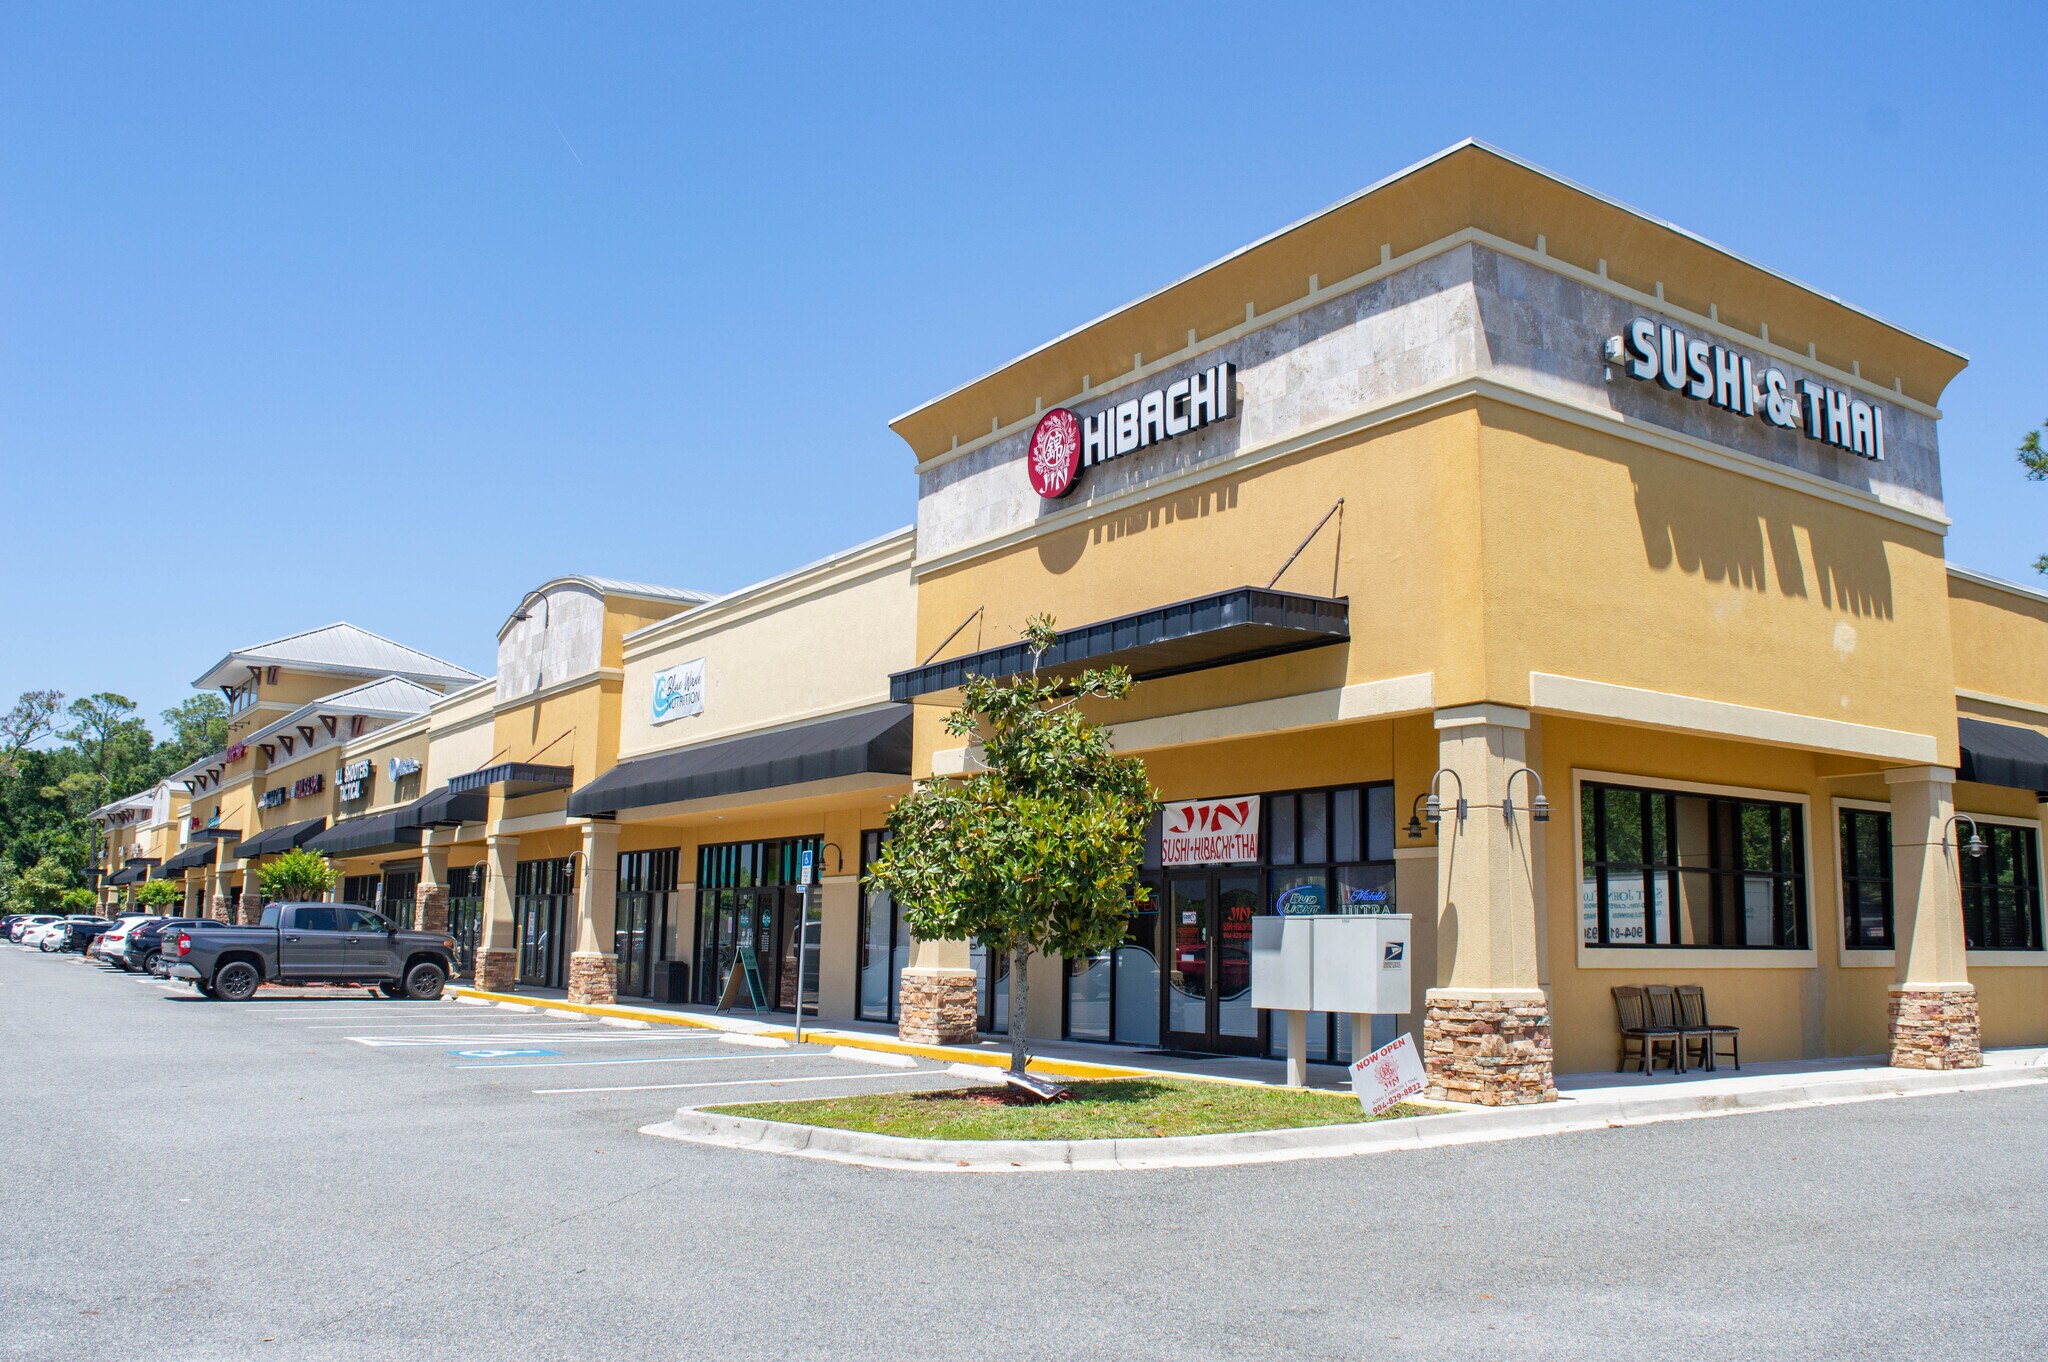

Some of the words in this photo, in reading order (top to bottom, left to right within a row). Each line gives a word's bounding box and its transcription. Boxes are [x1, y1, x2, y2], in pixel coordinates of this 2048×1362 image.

[1627, 317, 1754, 416] SUSHI
[1760, 367, 1797, 429] &
[1799, 379, 1884, 461] THAI
[1083, 362, 1231, 467] HIBACHI
[1039, 467, 1068, 493] JIN
[666, 674, 682, 697] Blue
[684, 670, 701, 691] Wave
[1168, 801, 1249, 833] JIN
[1283, 904, 1320, 914] LIGHT
[1290, 893, 1317, 904] BUD
[1227, 907, 1251, 920] JIN
[1356, 1052, 1378, 1071] NOW
[1380, 1038, 1406, 1057] OPEN
[1373, 1082, 1422, 1114] 904-829-8822
